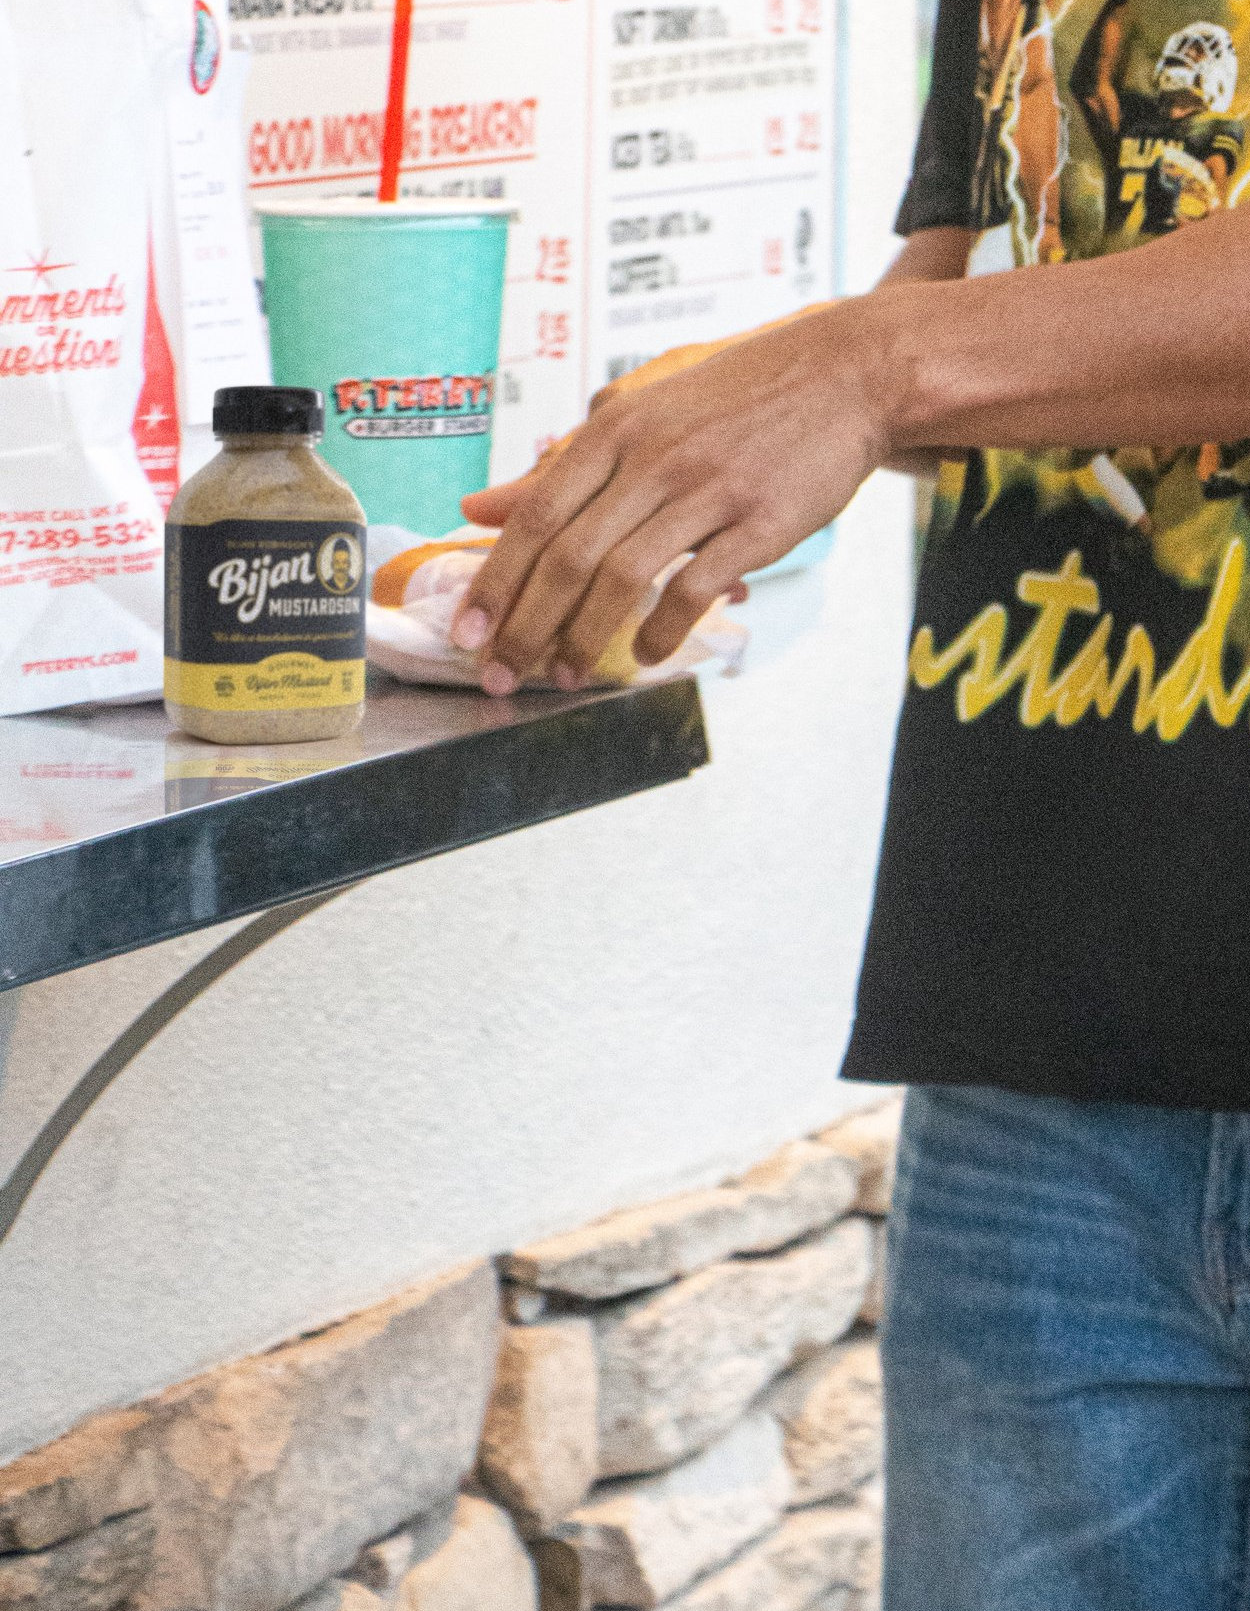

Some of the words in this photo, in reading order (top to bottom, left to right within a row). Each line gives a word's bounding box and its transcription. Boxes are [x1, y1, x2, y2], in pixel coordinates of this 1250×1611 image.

[250, 116, 316, 175] GOOD
[320, 109, 422, 169] MORNG
[428, 96, 539, 158] BREAKFAST
[1119, 172, 1147, 240] 7
[208, 551, 317, 624] Bijan
[268, 596, 361, 618] MUSTARDSON
